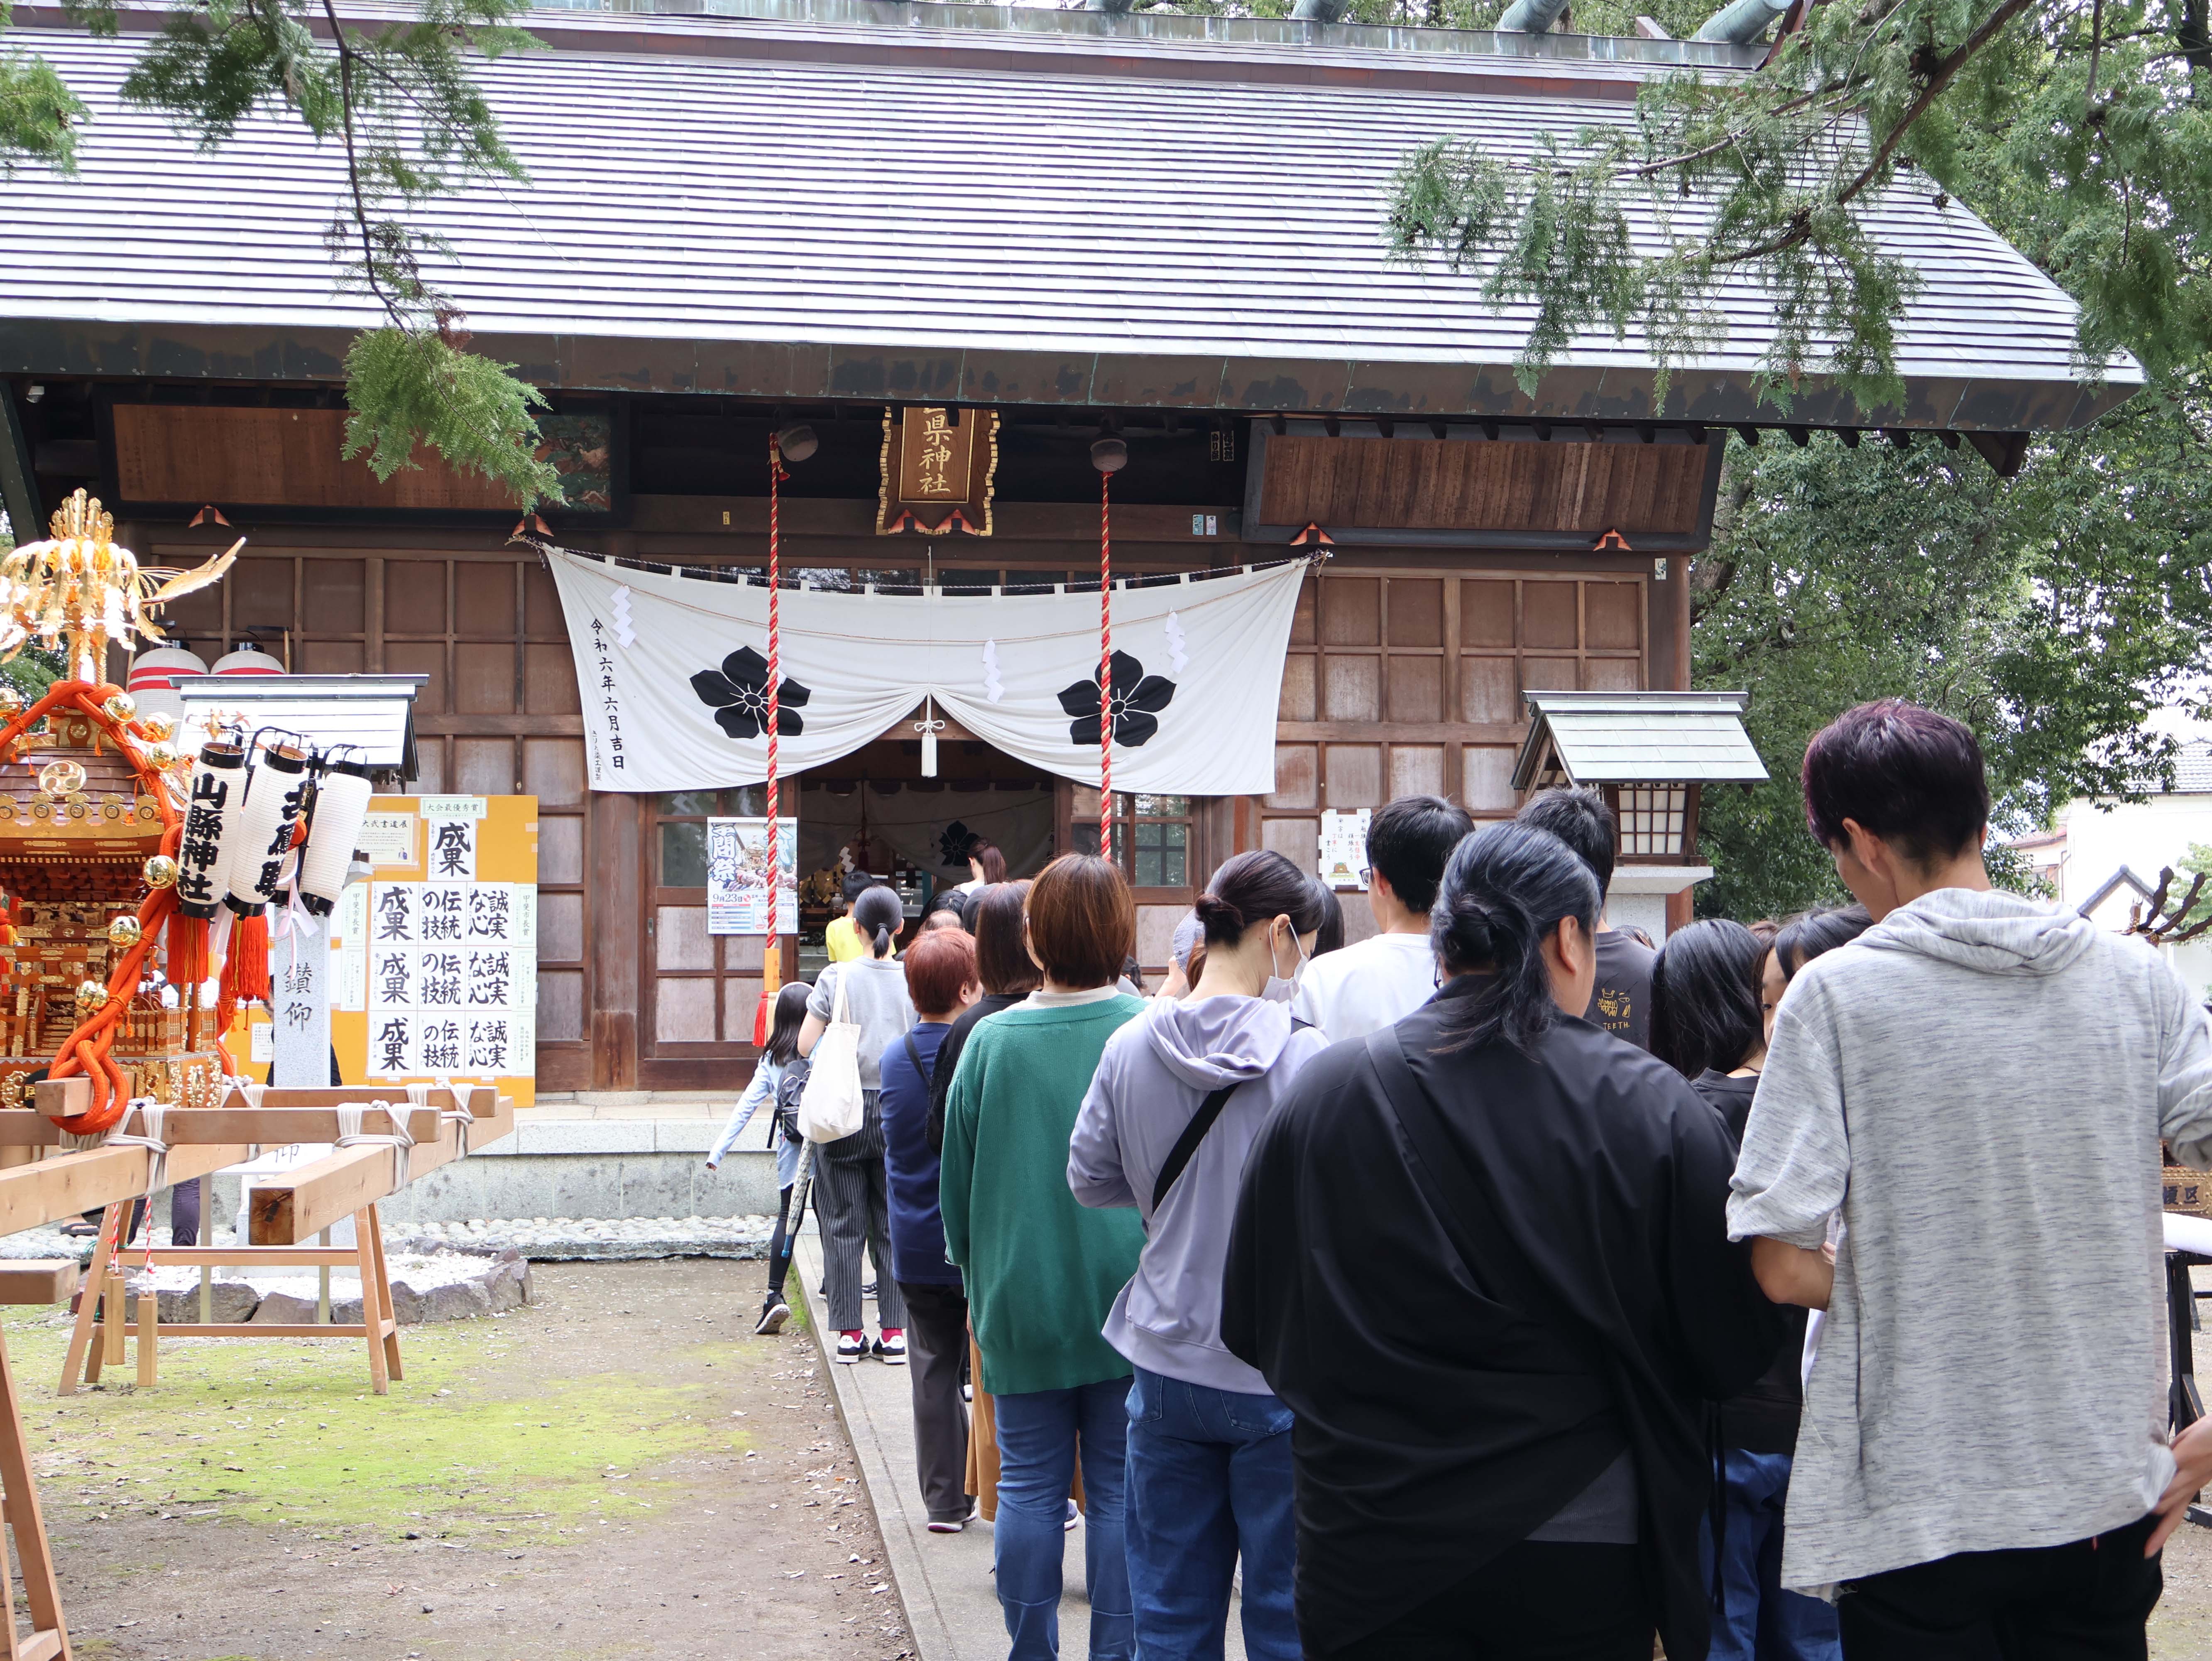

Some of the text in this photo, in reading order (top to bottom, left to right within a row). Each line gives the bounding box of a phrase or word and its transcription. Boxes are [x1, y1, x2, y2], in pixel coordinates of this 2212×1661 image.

[916, 407, 953, 495] 県神社
[590, 618, 624, 769] 令和六年六月吉日
[177, 772, 228, 901] 山縣神社
[434, 822, 471, 877] 成果
[352, 893, 360, 935] 甲斐市長賞
[377, 887, 414, 941] 成果
[422, 891, 443, 940] の技
[441, 889, 462, 940] 伝統
[468, 889, 489, 936] な心
[487, 890, 509, 939] 誠実
[522, 895, 531, 936] 甲斐市長賞
[713, 893, 742, 902] 9月23日
[379, 953, 411, 1004] 成果
[421, 953, 443, 1004] の技
[440, 953, 461, 1004] 伝統
[468, 951, 489, 1004] な心
[486, 951, 509, 1005] 誠実
[378, 1017, 410, 1071] 成果
[423, 1026, 441, 1068] の技
[440, 1019, 459, 1068] 伝統
[469, 1021, 488, 1067] な心
[486, 1020, 507, 1068] 誠実
[1603, 1021, 1630, 1030] TEETH.
